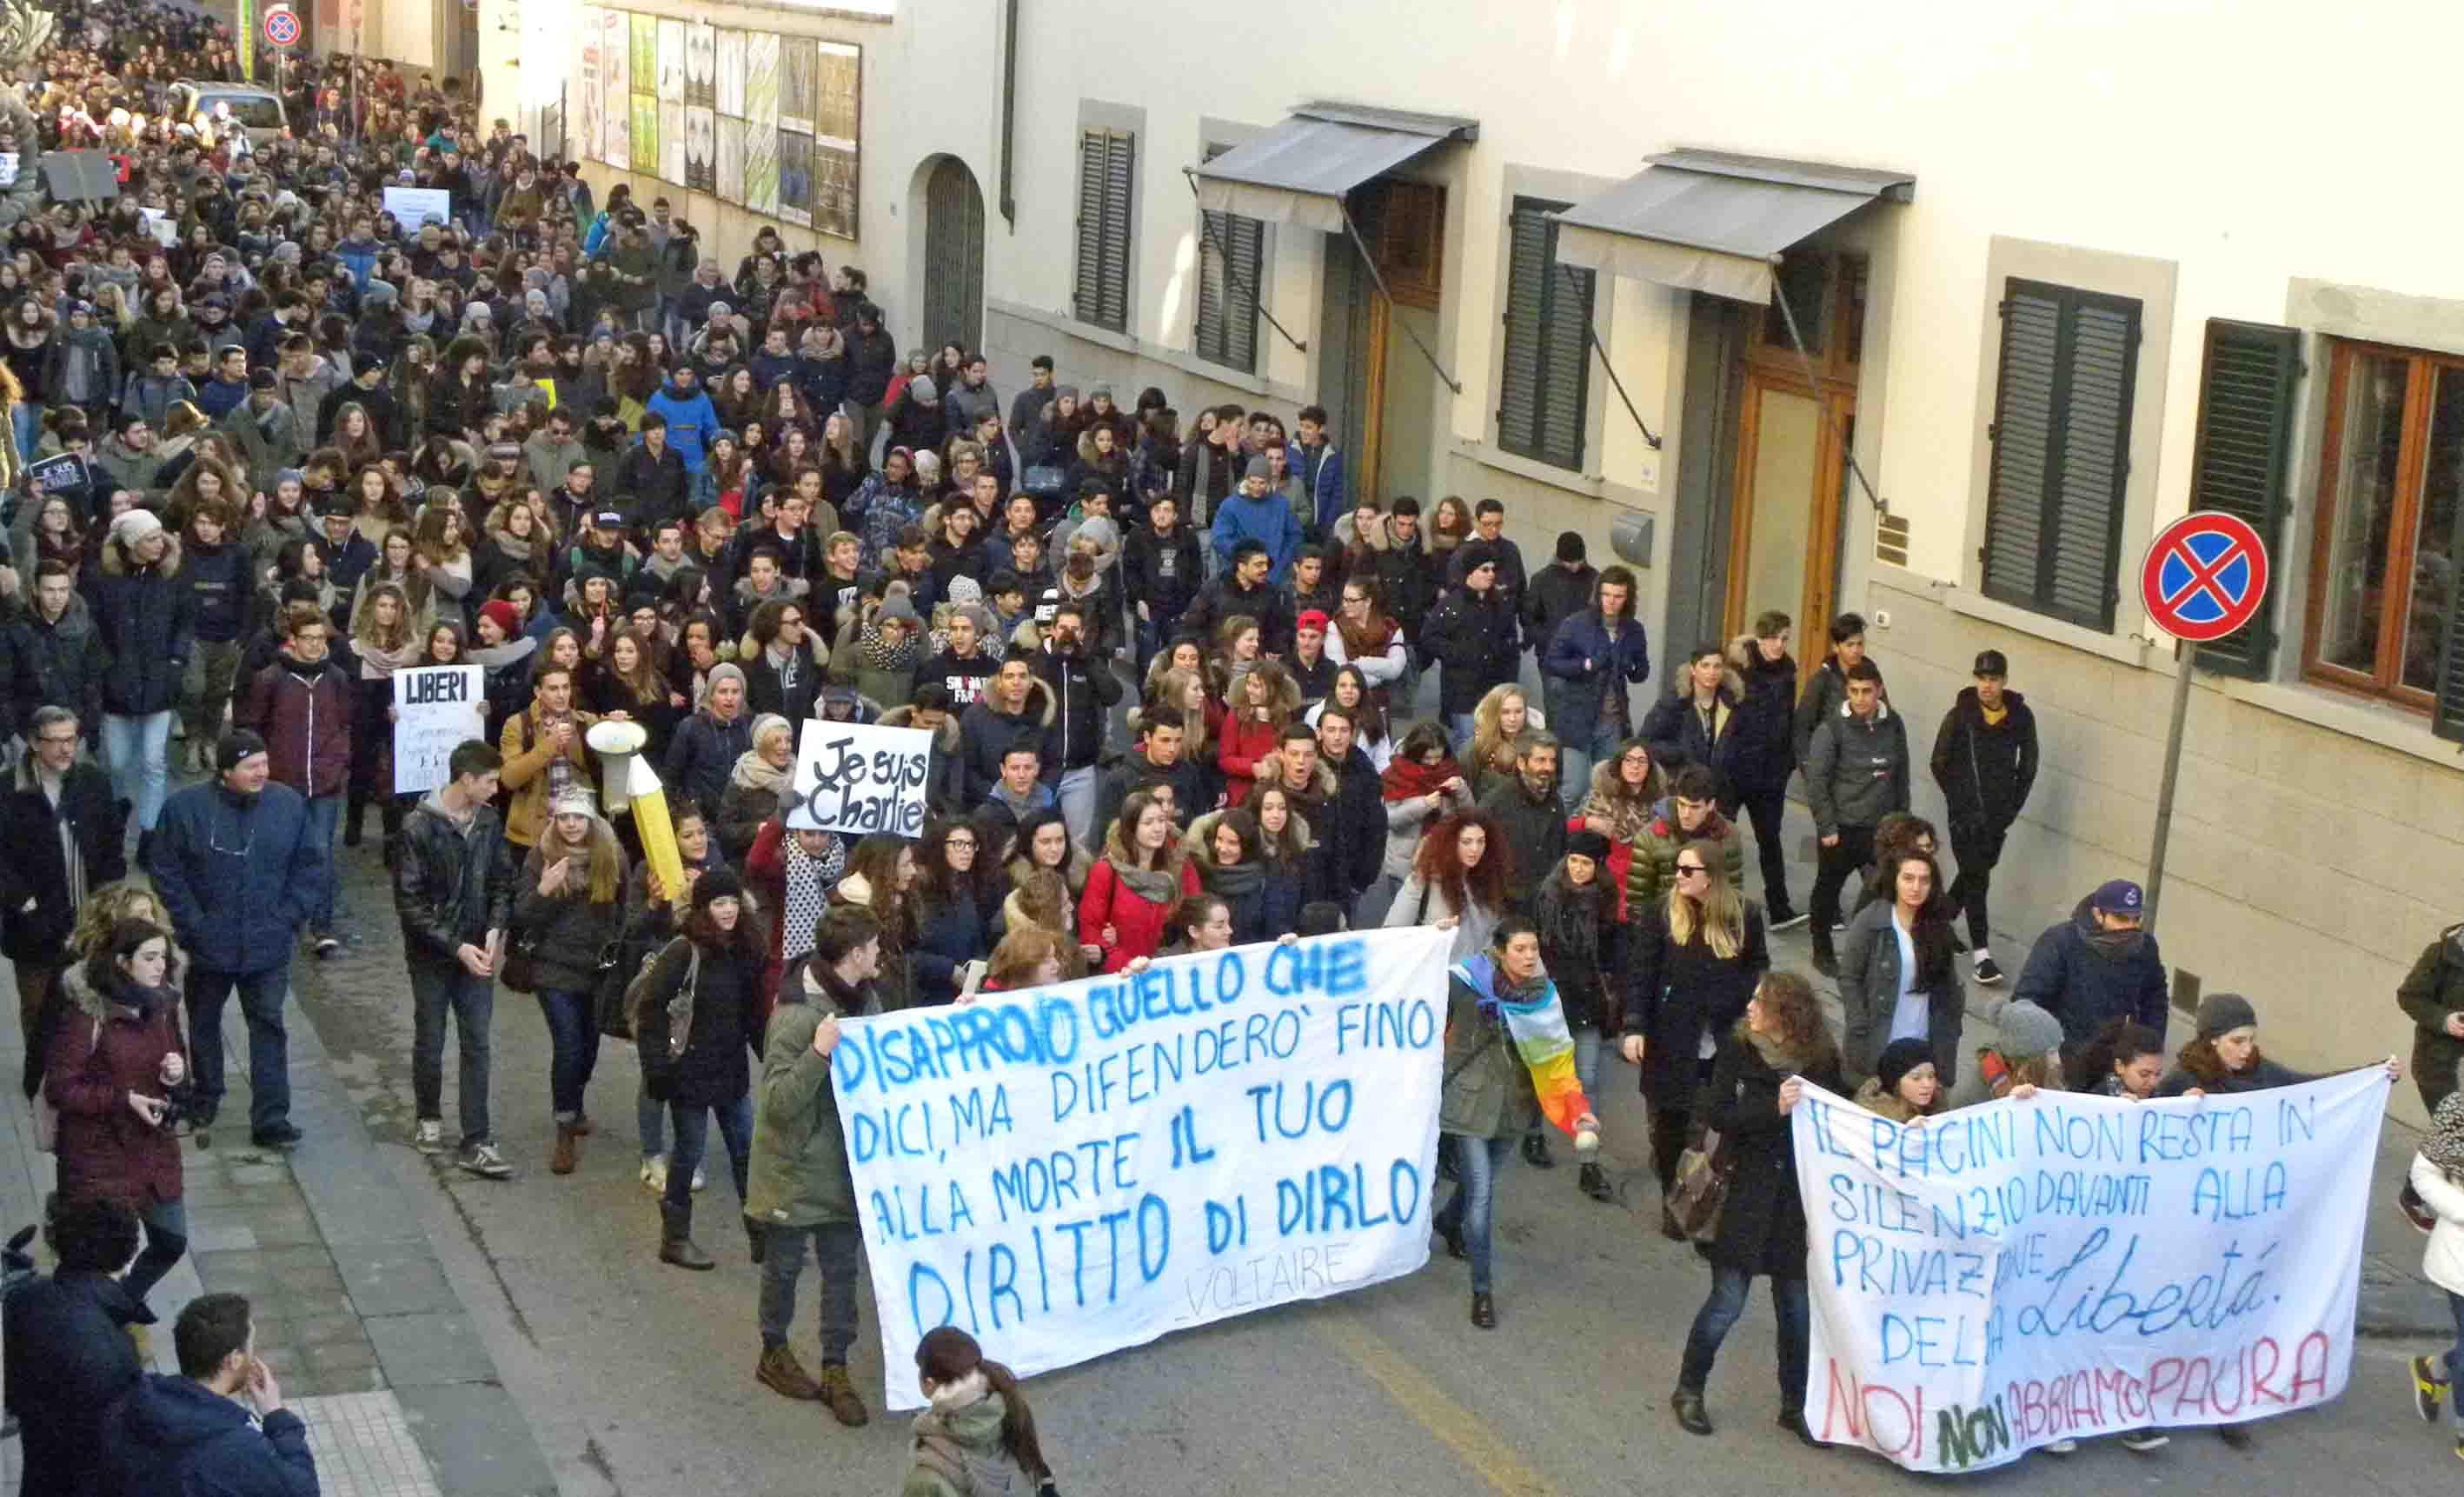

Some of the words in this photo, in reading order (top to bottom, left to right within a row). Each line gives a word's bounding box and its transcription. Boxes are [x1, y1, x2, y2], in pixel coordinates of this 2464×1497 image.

[405, 671, 468, 704] LIBERI
[807, 781, 923, 832] Charlie
[814, 737, 867, 784] Je
[872, 750, 926, 792] suis
[833, 995, 1079, 1094] DISAPPROVO
[1087, 951, 1245, 1039] QUELLO
[1265, 939, 1369, 998] CHE
[948, 1082, 1013, 1145] MA
[1337, 999, 1435, 1055] FINO
[870, 1181, 974, 1245] ALLA
[993, 1133, 1140, 1222] MORTE
[1171, 1105, 1215, 1169] IL
[1246, 1079, 1353, 1142] TUO
[1810, 1098, 1856, 1160] IL
[1872, 1109, 2016, 1178] PACINI
[2035, 1104, 2124, 1161] NON
[2139, 1106, 2251, 1163] RESTA
[2278, 1095, 2315, 1143] IN
[909, 1193, 1170, 1336] DIRITTO
[1205, 1195, 1247, 1255] DI
[1277, 1158, 1421, 1236] DIRLO
[1830, 1174, 2026, 1241] SILENZIO
[2036, 1170, 2149, 1215] DAVANTI
[2192, 1161, 2287, 1222] ALLA
[1822, 1358, 1923, 1460] NOI
[1936, 1393, 2010, 1468] NON
[2007, 1367, 2142, 1443] ABBIAMO
[2148, 1331, 2329, 1421] PAURA
